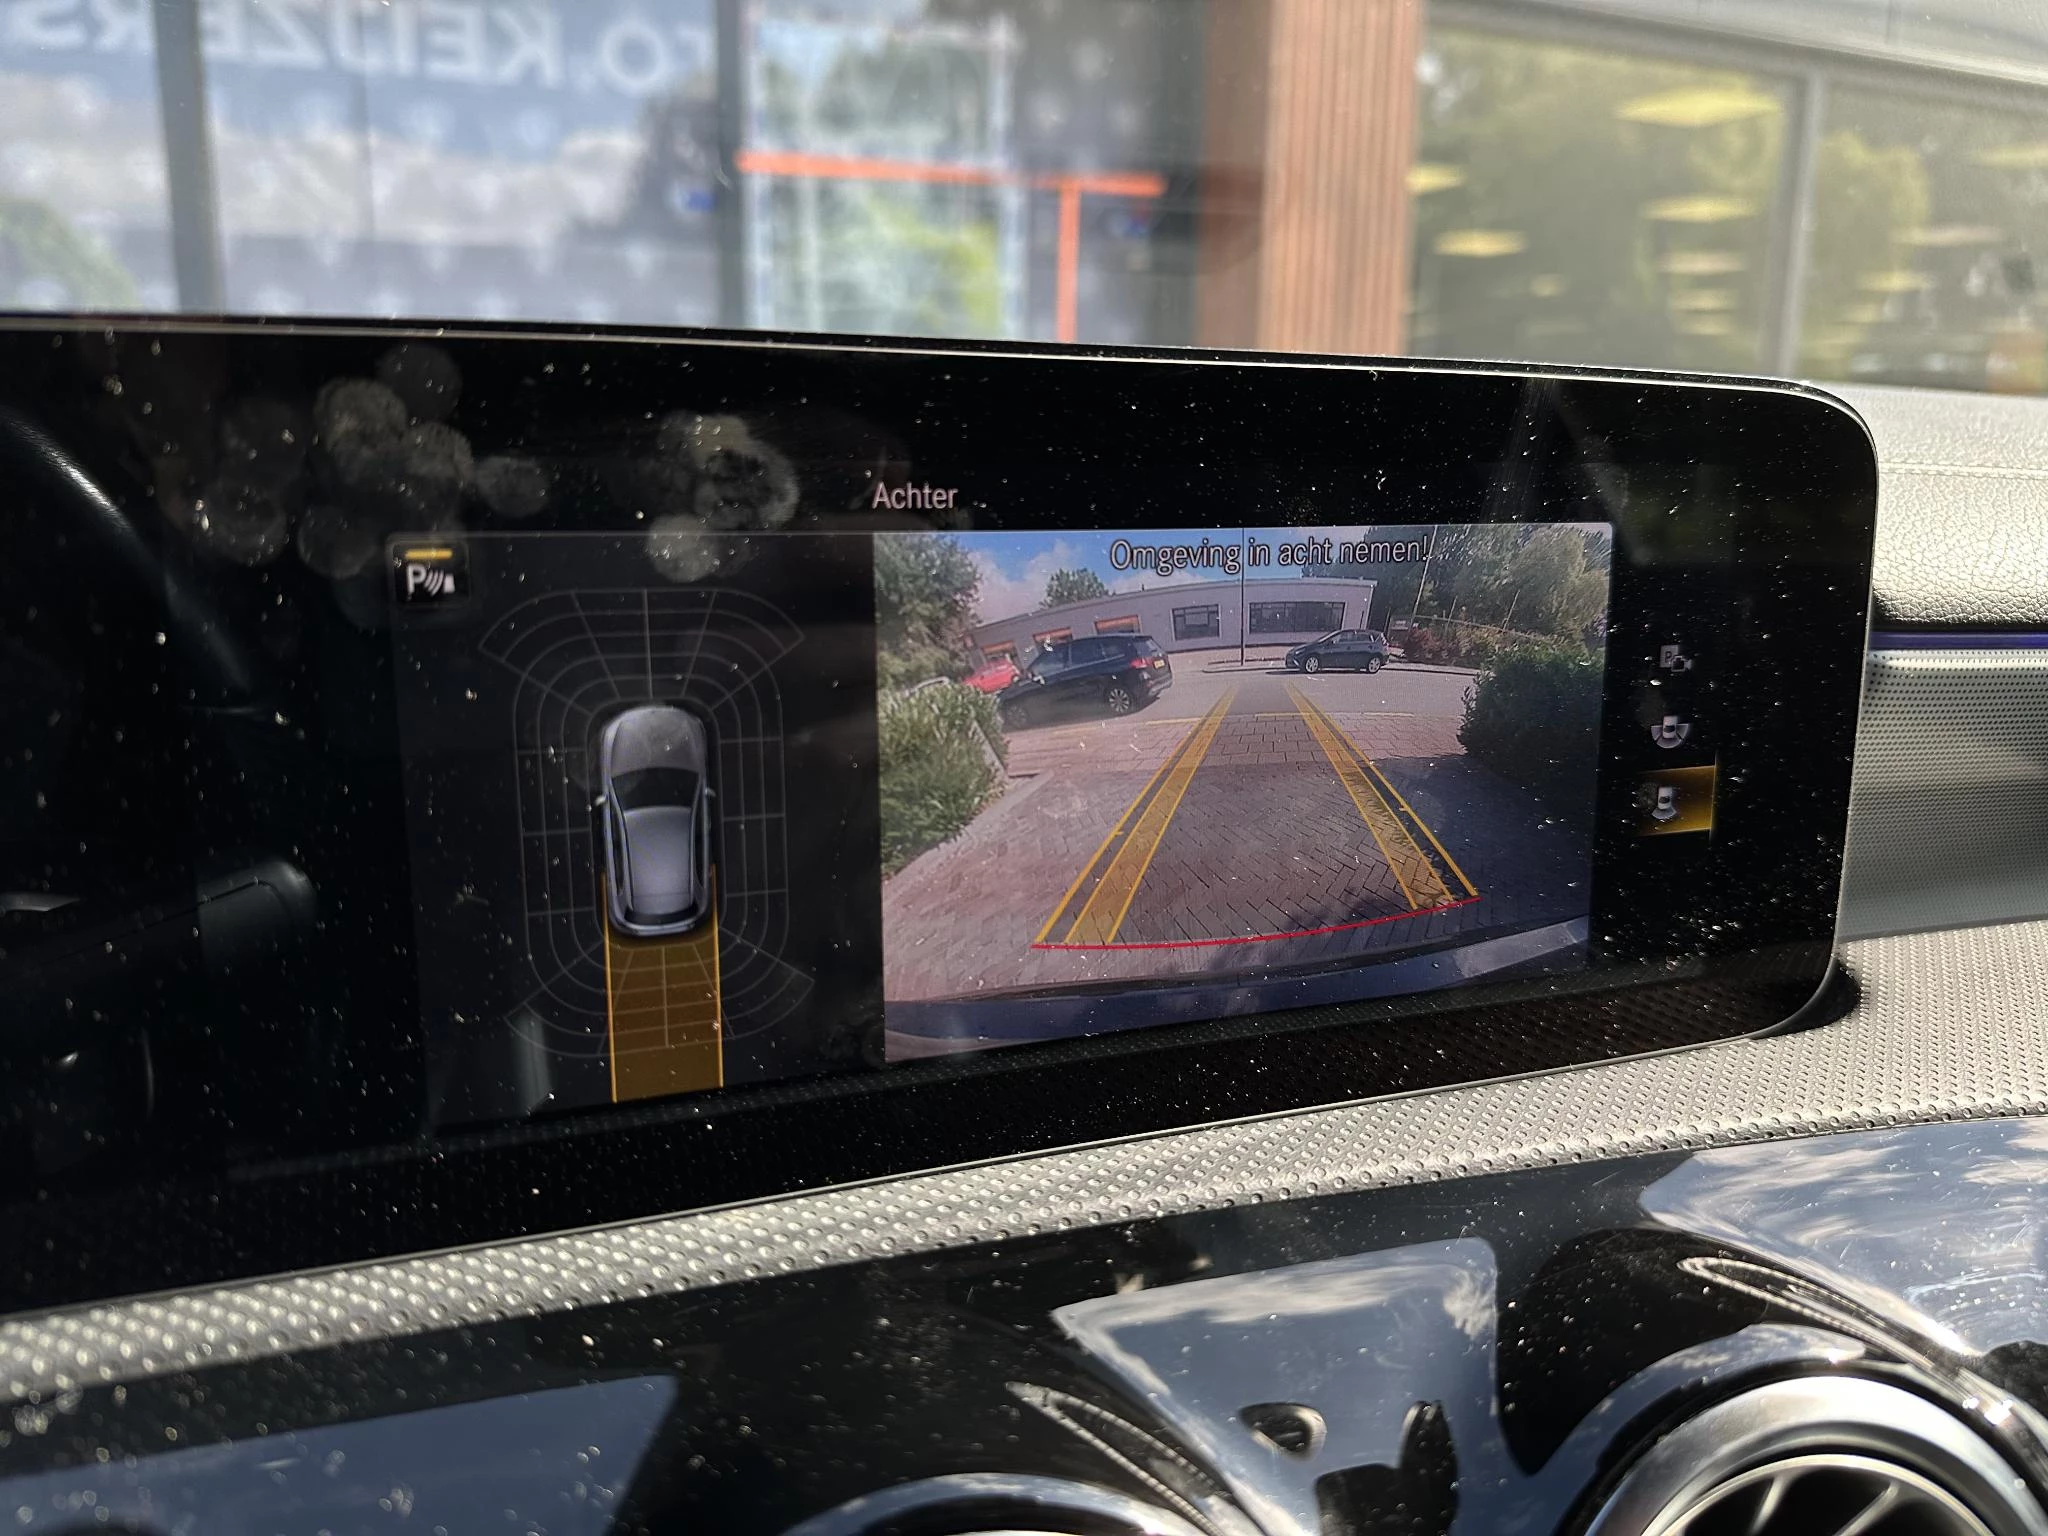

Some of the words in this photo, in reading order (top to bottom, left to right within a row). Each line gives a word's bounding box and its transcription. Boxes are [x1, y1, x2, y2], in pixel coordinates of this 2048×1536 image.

[872, 481, 959, 509] Achter
[1110, 538, 1240, 576] Omgeving
[1248, 537, 1270, 566] in
[1278, 536, 1331, 565] acht
[1339, 535, 1429, 564] nemen!
[406, 564, 427, 594] P
